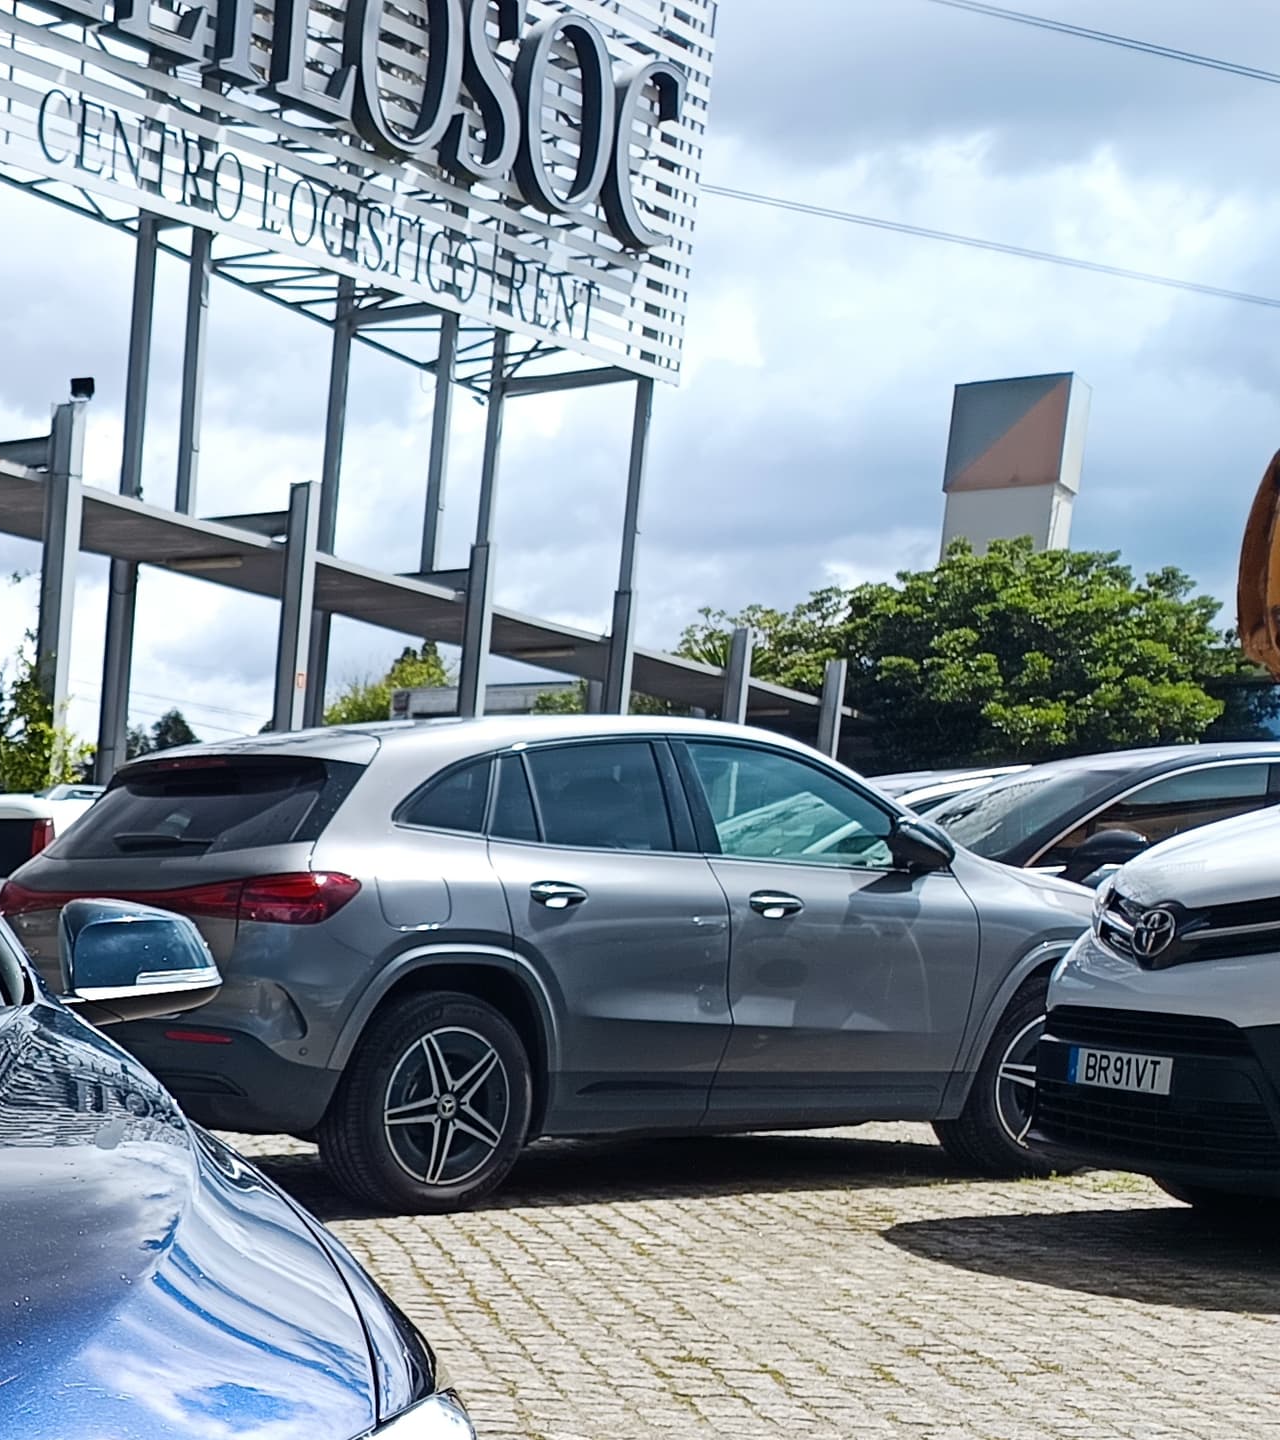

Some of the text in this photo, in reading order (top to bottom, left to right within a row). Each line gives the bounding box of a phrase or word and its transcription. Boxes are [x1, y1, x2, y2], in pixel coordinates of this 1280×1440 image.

[10, 0, 686, 247] LOSOC
[37, 88, 244, 222] CENTRO
[508, 258, 600, 342] RENT
